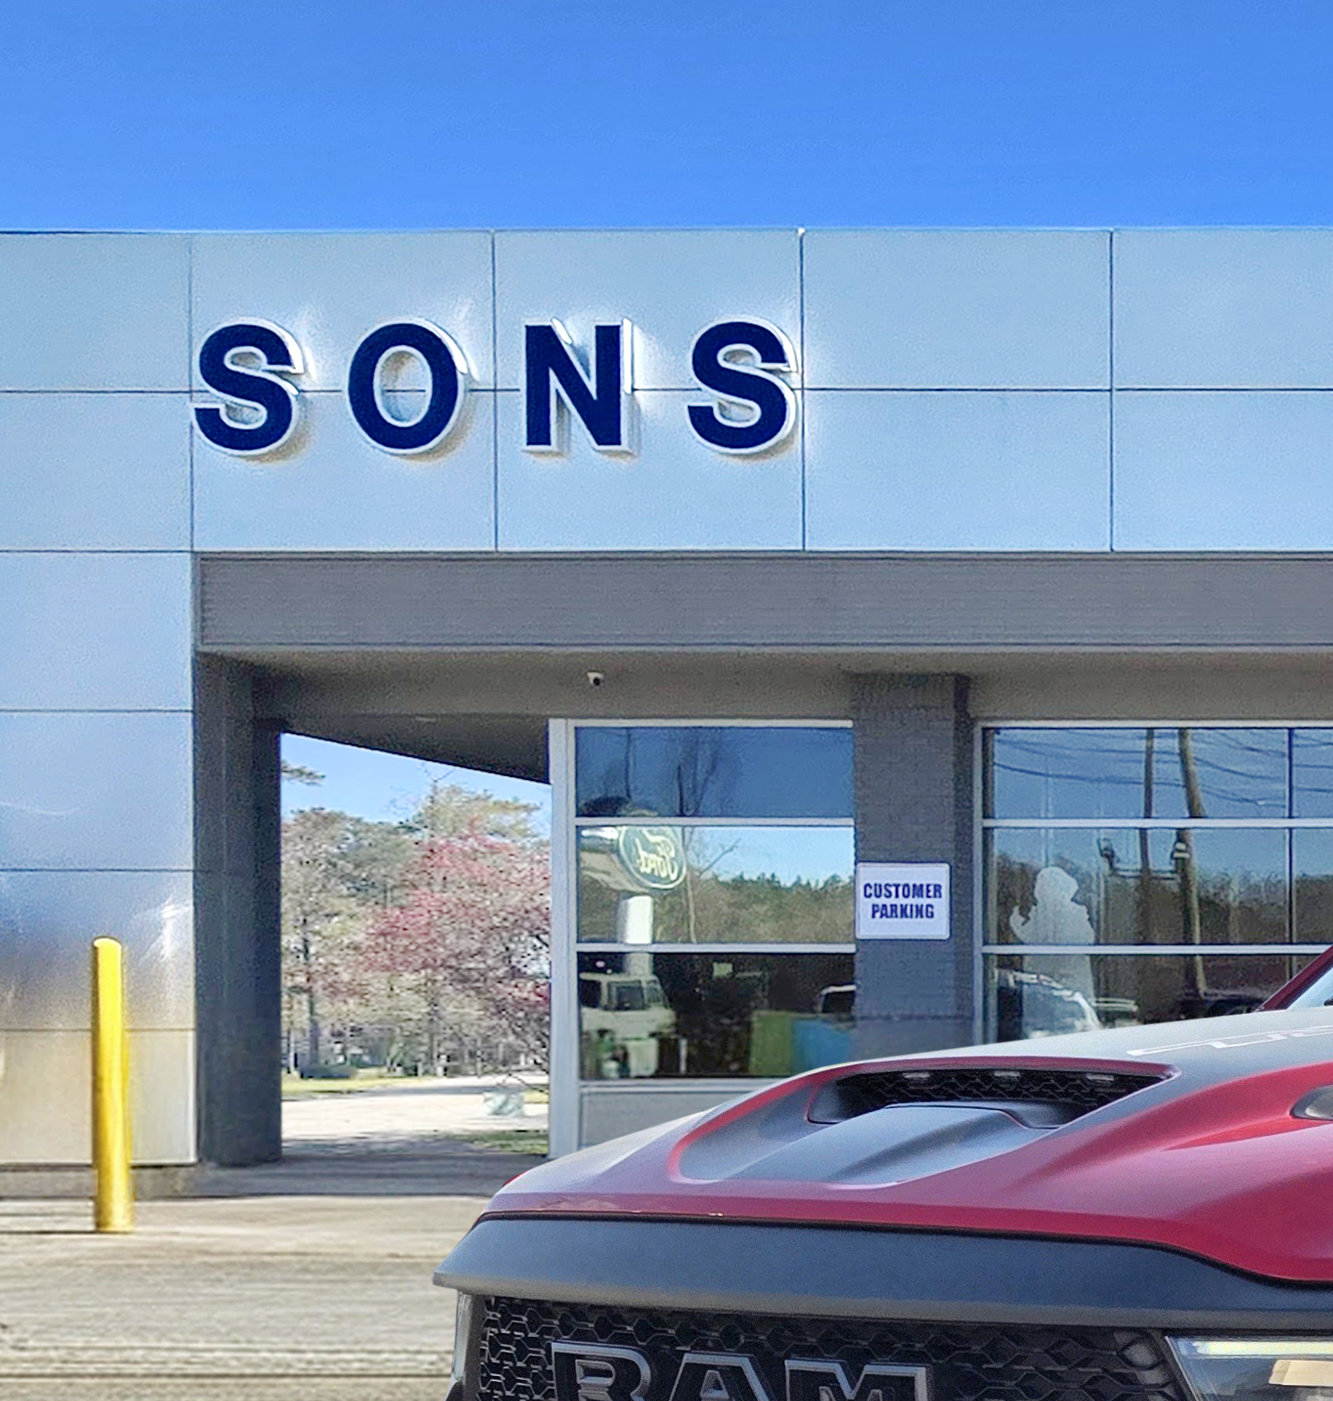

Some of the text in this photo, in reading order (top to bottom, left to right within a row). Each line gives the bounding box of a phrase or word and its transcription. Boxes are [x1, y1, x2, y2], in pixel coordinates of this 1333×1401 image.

[192, 317, 798, 457] SONS
[863, 882, 943, 899] CUSTOMER
[871, 903, 935, 920] PARKING
